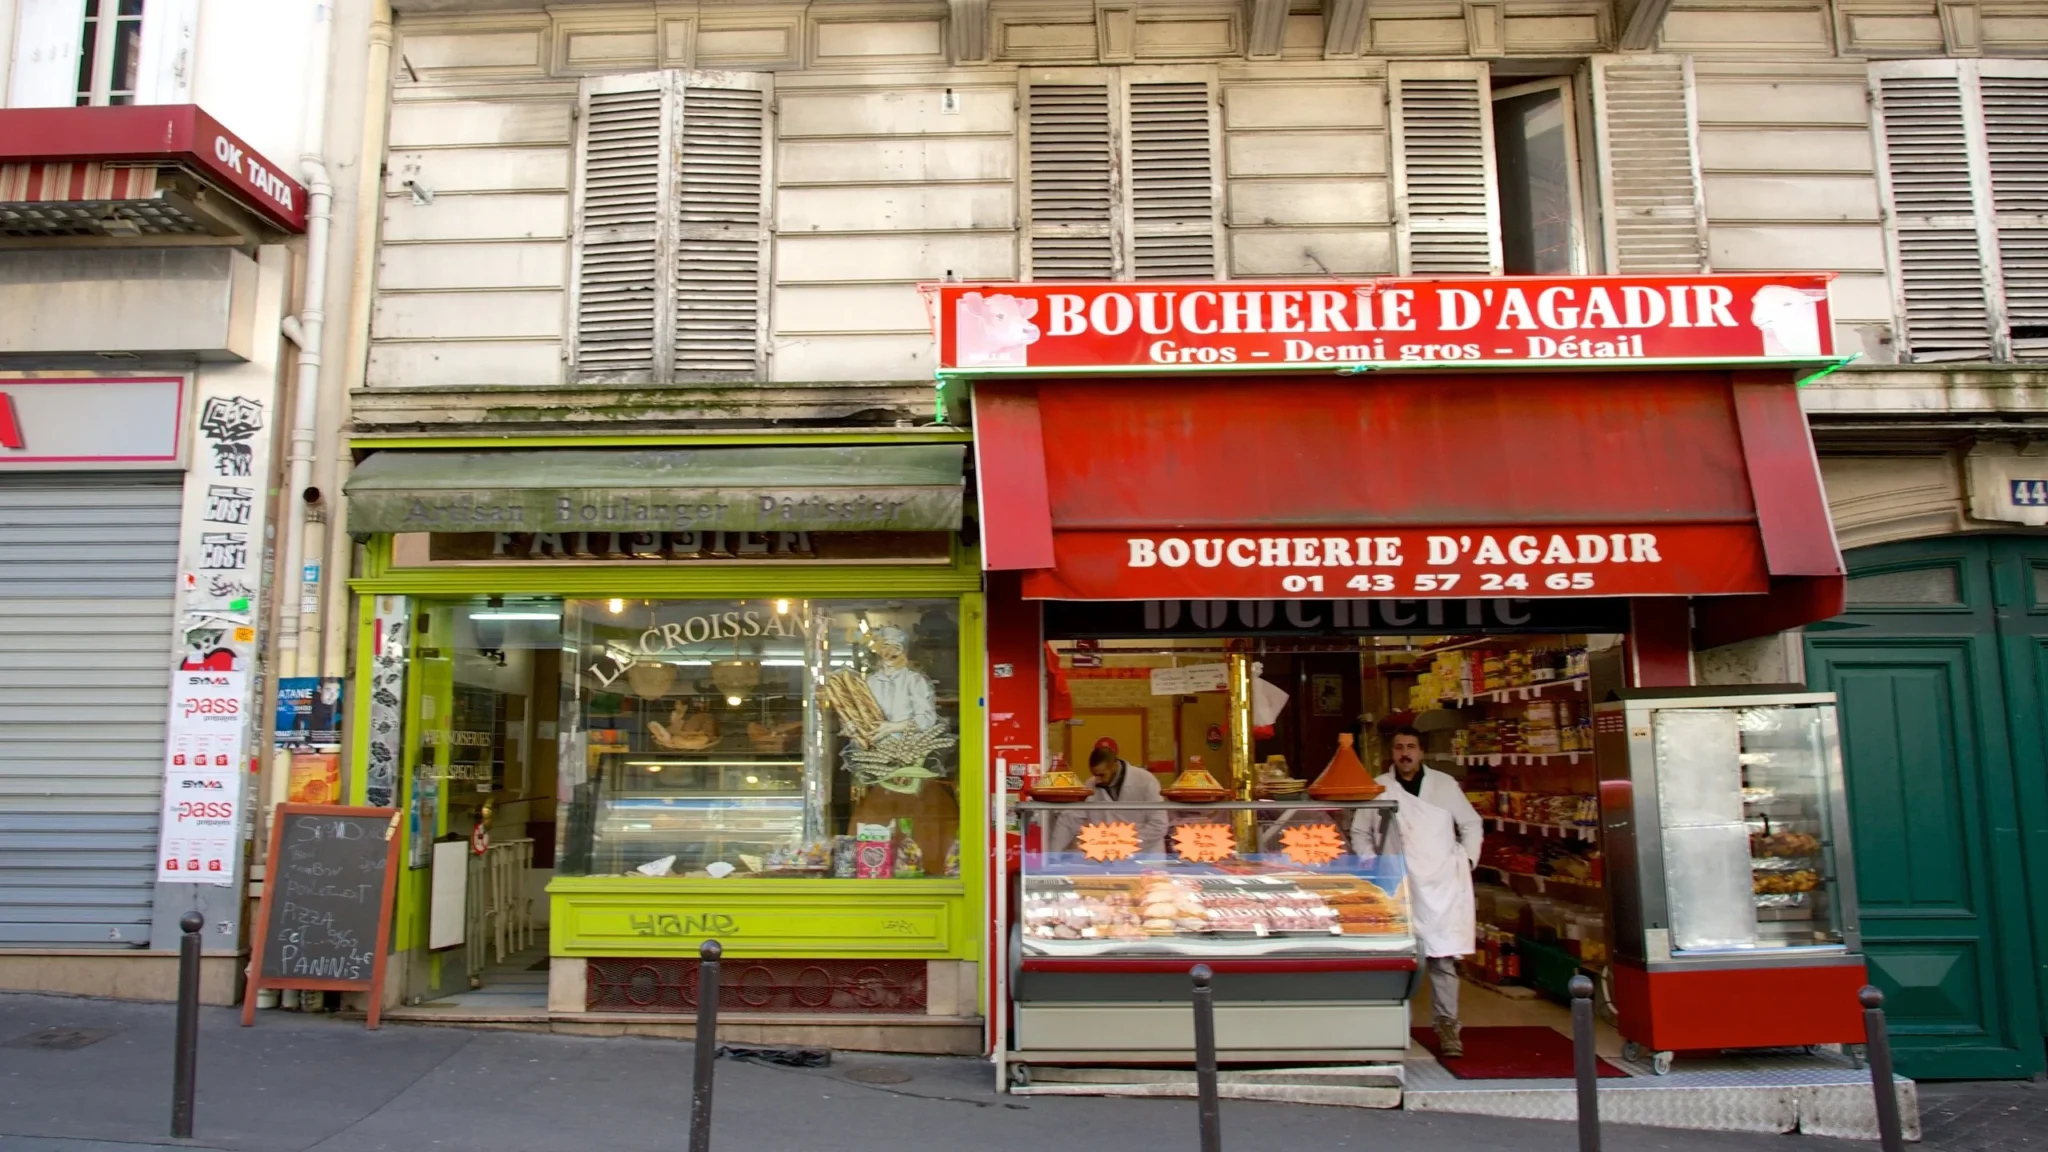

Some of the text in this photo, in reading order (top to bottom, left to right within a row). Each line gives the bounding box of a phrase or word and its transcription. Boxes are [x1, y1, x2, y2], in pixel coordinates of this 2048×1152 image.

[215, 135, 293, 211] OK TAITA
[1047, 284, 1739, 336] BOUCHERIE D'AGADIR
[1149, 340, 1238, 363] Gros
[1284, 338, 1387, 361] Demi
[1399, 341, 1480, 361] gros
[1527, 334, 1645, 358] Détail
[2014, 481, 2047, 504] 44
[405, 494, 905, 529] Artisan Boulanger Pâtissier
[1127, 537, 1404, 568] BOUCHERIE
[1281, 572, 1596, 593] 01 43 57 24 65
[188, 676, 230, 686] SYMA
[184, 697, 239, 719] pass
[181, 779, 224, 789] SYMA
[177, 801, 233, 823] pass
